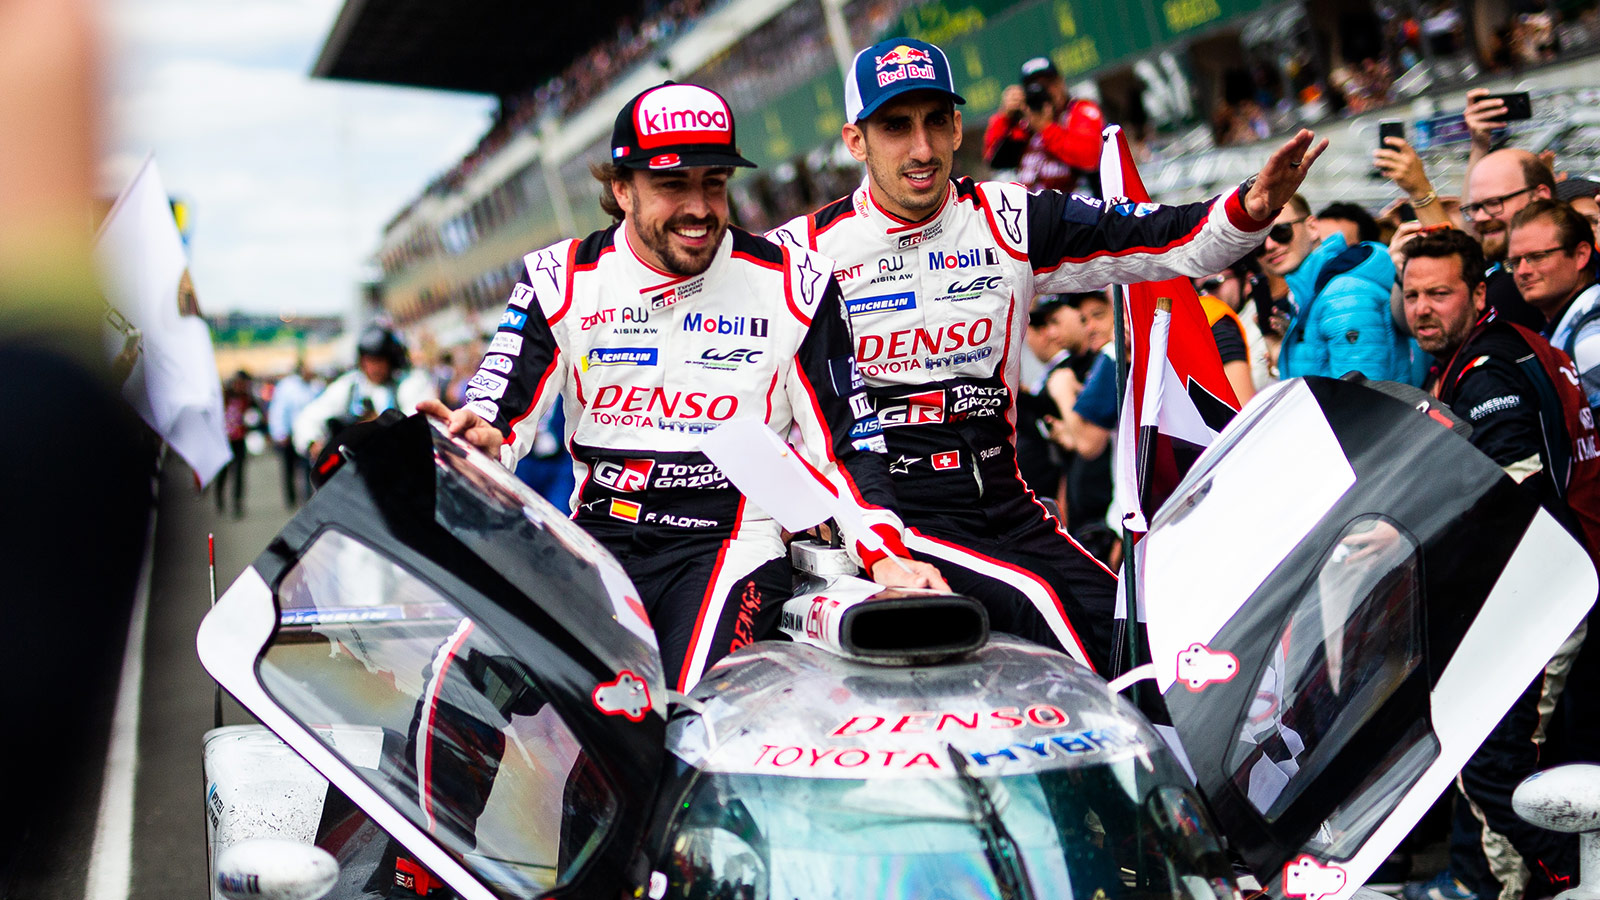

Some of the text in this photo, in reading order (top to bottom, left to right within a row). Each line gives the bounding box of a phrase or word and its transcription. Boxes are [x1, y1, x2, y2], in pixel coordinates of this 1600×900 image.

[877, 64, 936, 87] Red Bull
[643, 106, 727, 134] kimoa
[899, 234, 922, 248] GR
[929, 250, 981, 271] Mobil
[833, 263, 864, 283] ENT
[869, 273, 914, 285] AISIN AW
[652, 294, 677, 310] GR
[849, 298, 909, 313] MICHELIN
[581, 308, 616, 331] ZENT
[683, 312, 766, 337] Mobil 1
[856, 317, 993, 363] DENSO
[601, 352, 652, 362] ICHELIN
[859, 346, 993, 377] TOYOTA HYBRID
[591, 384, 739, 421] DENSO
[591, 412, 653, 428] TOYOTA
[877, 404, 943, 425] GR
[594, 460, 648, 491] GR
[657, 463, 721, 477] TOYO
[644, 512, 718, 528] F. ALONSO
[830, 704, 1067, 737] DENSO
[754, 744, 941, 769] TOYOTA
